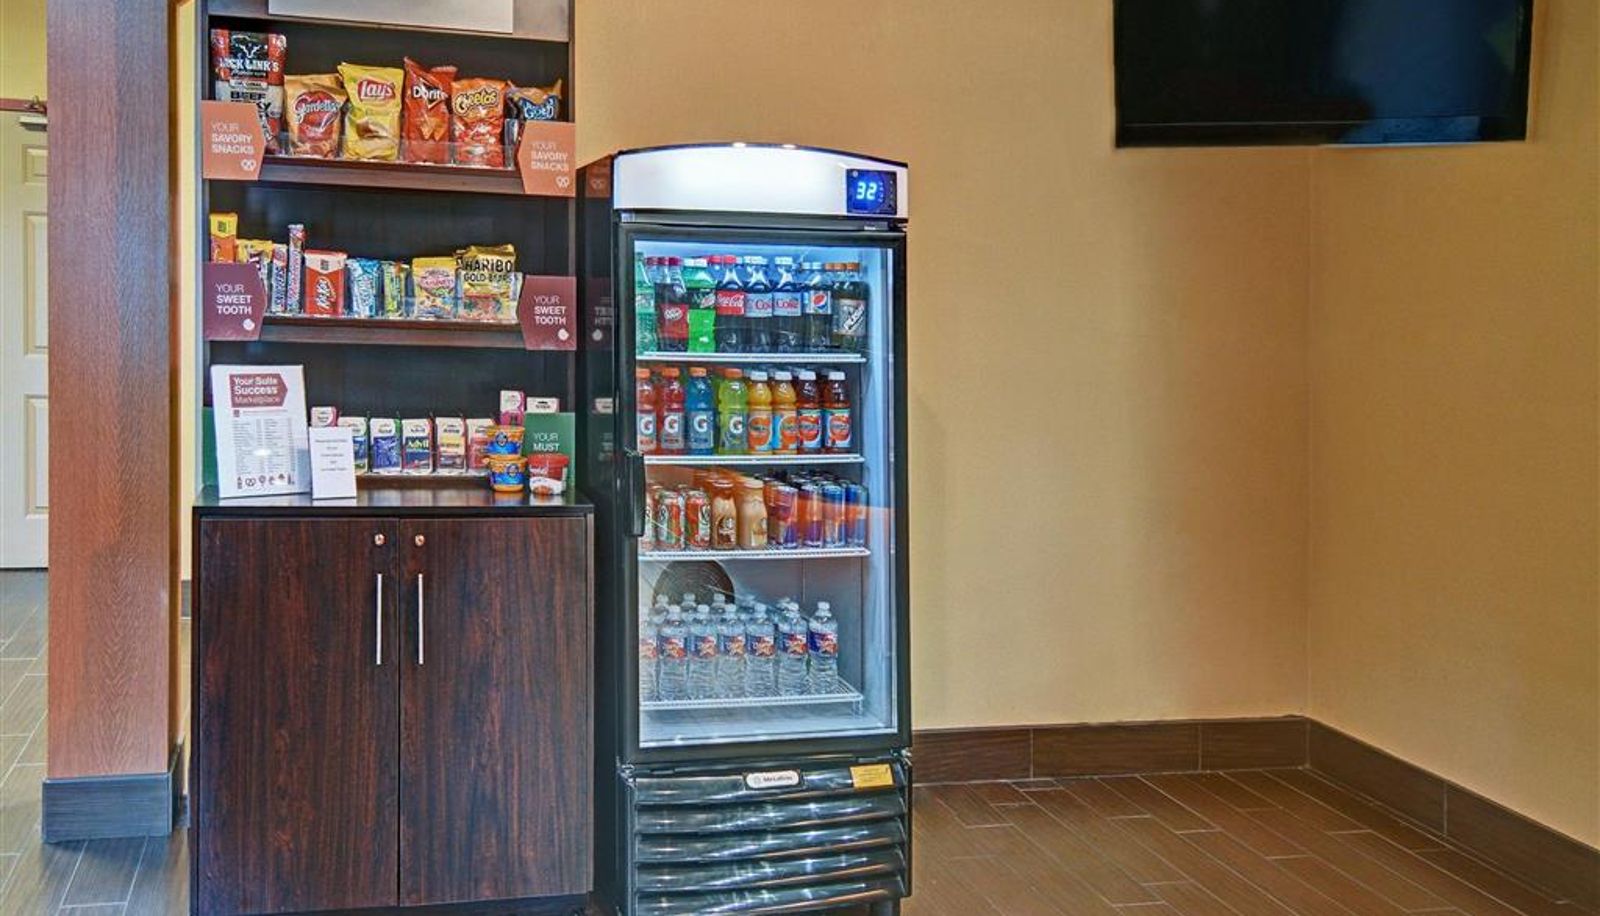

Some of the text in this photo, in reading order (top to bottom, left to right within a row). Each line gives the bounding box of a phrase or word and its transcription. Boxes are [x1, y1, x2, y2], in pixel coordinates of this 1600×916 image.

[360, 80, 395, 99] Lay's
[413, 86, 449, 99] Dorit
[455, 90, 498, 112] Cheetos
[212, 122, 240, 131] YOUR
[212, 133, 253, 143] SAVORY
[212, 144, 254, 154] SNACKS
[532, 142, 557, 151] YOUR
[531, 150, 568, 161] SAVORY
[531, 161, 569, 171] SNACKS
[856, 181, 877, 200] 32
[464, 259, 513, 272] HARIBO
[215, 283, 244, 293] YOUR
[216, 294, 253, 304] SWEET
[534, 295, 560, 304] YOUR
[216, 305, 253, 315] TOOTH
[534, 305, 567, 315] SWEET
[535, 315, 567, 325] TOOTH
[234, 376, 254, 386] Your
[234, 386, 278, 395] Success
[641, 416, 653, 434] G
[664, 415, 679, 433] G
[694, 415, 708, 432] G
[729, 416, 743, 434] G
[533, 432, 559, 442] YOUR
[533, 443, 560, 452] MUST
